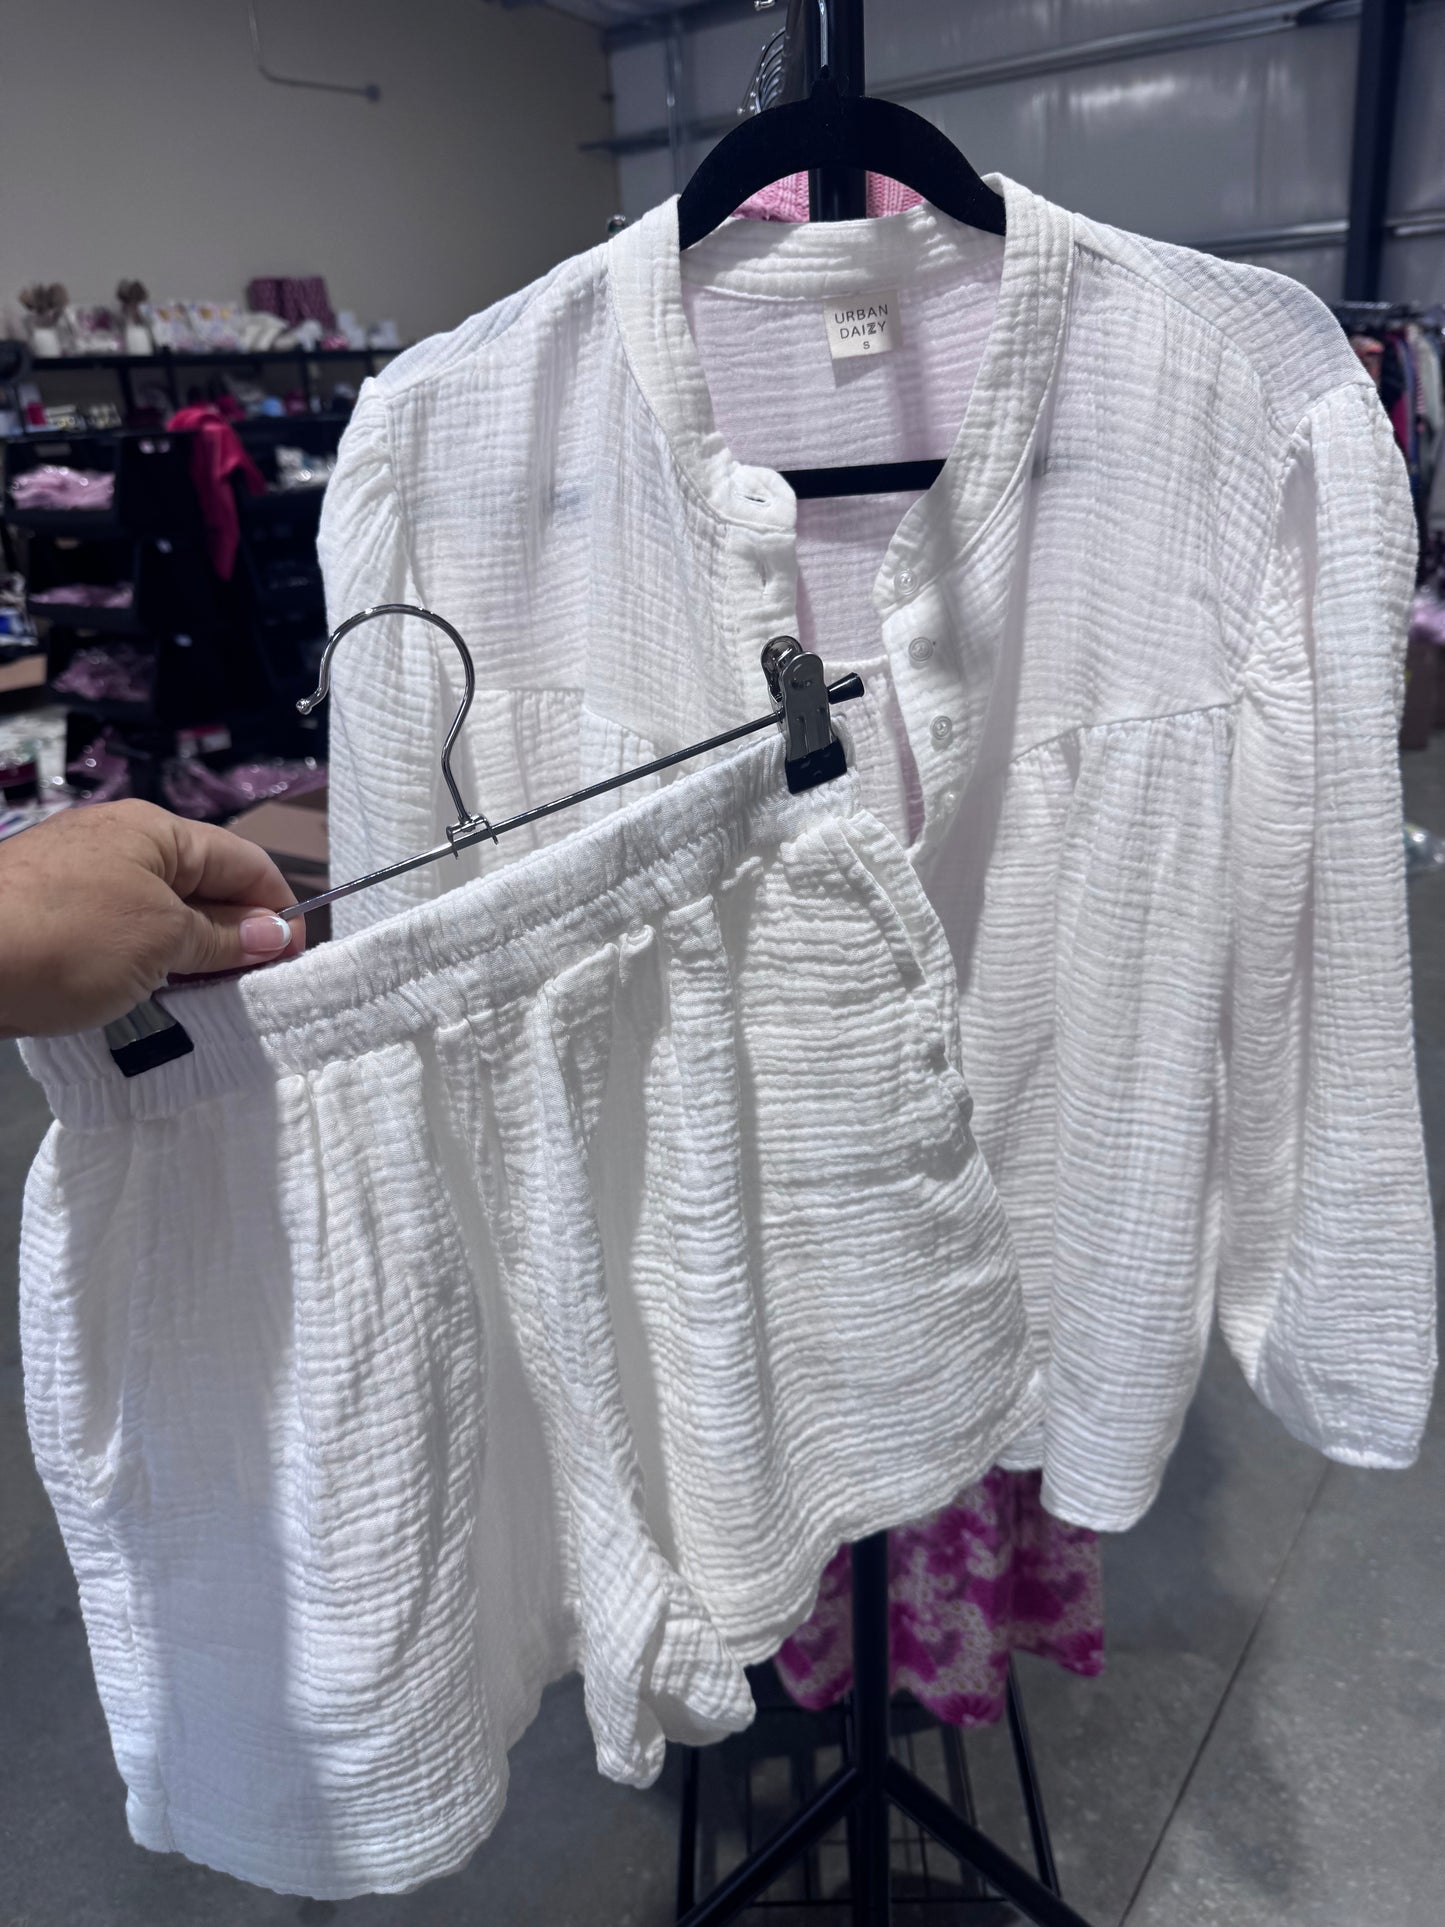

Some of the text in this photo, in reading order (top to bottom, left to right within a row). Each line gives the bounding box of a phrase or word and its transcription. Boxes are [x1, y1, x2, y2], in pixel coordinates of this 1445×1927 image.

[834, 304, 888, 324] URBAN
[840, 320, 886, 339] DAIZY
[862, 340, 871, 350] S
